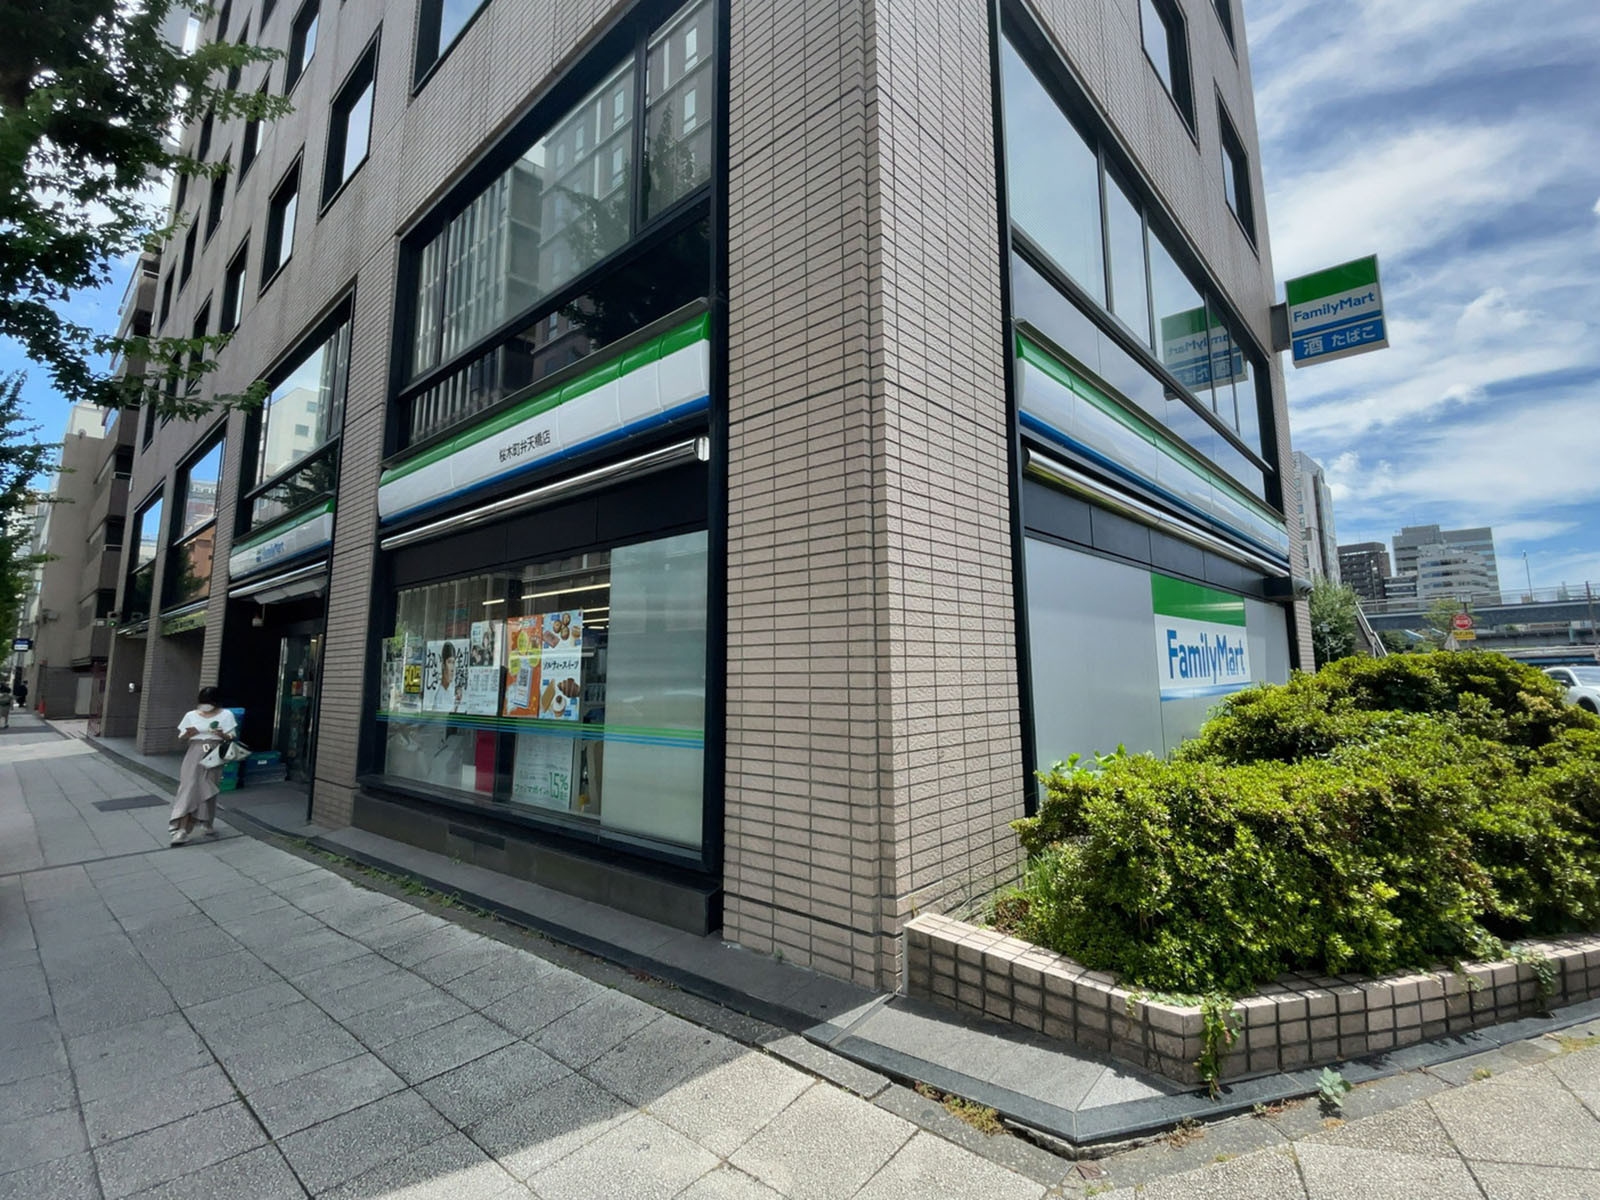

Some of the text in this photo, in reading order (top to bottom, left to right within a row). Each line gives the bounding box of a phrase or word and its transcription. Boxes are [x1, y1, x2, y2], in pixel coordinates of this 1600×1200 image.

[1293, 291, 1375, 323] FamilyMart
[1303, 325, 1376, 356] 酒 たばこ
[498, 429, 551, 463] 桜木町弁天橋店
[1166, 628, 1246, 685] FamilyMart
